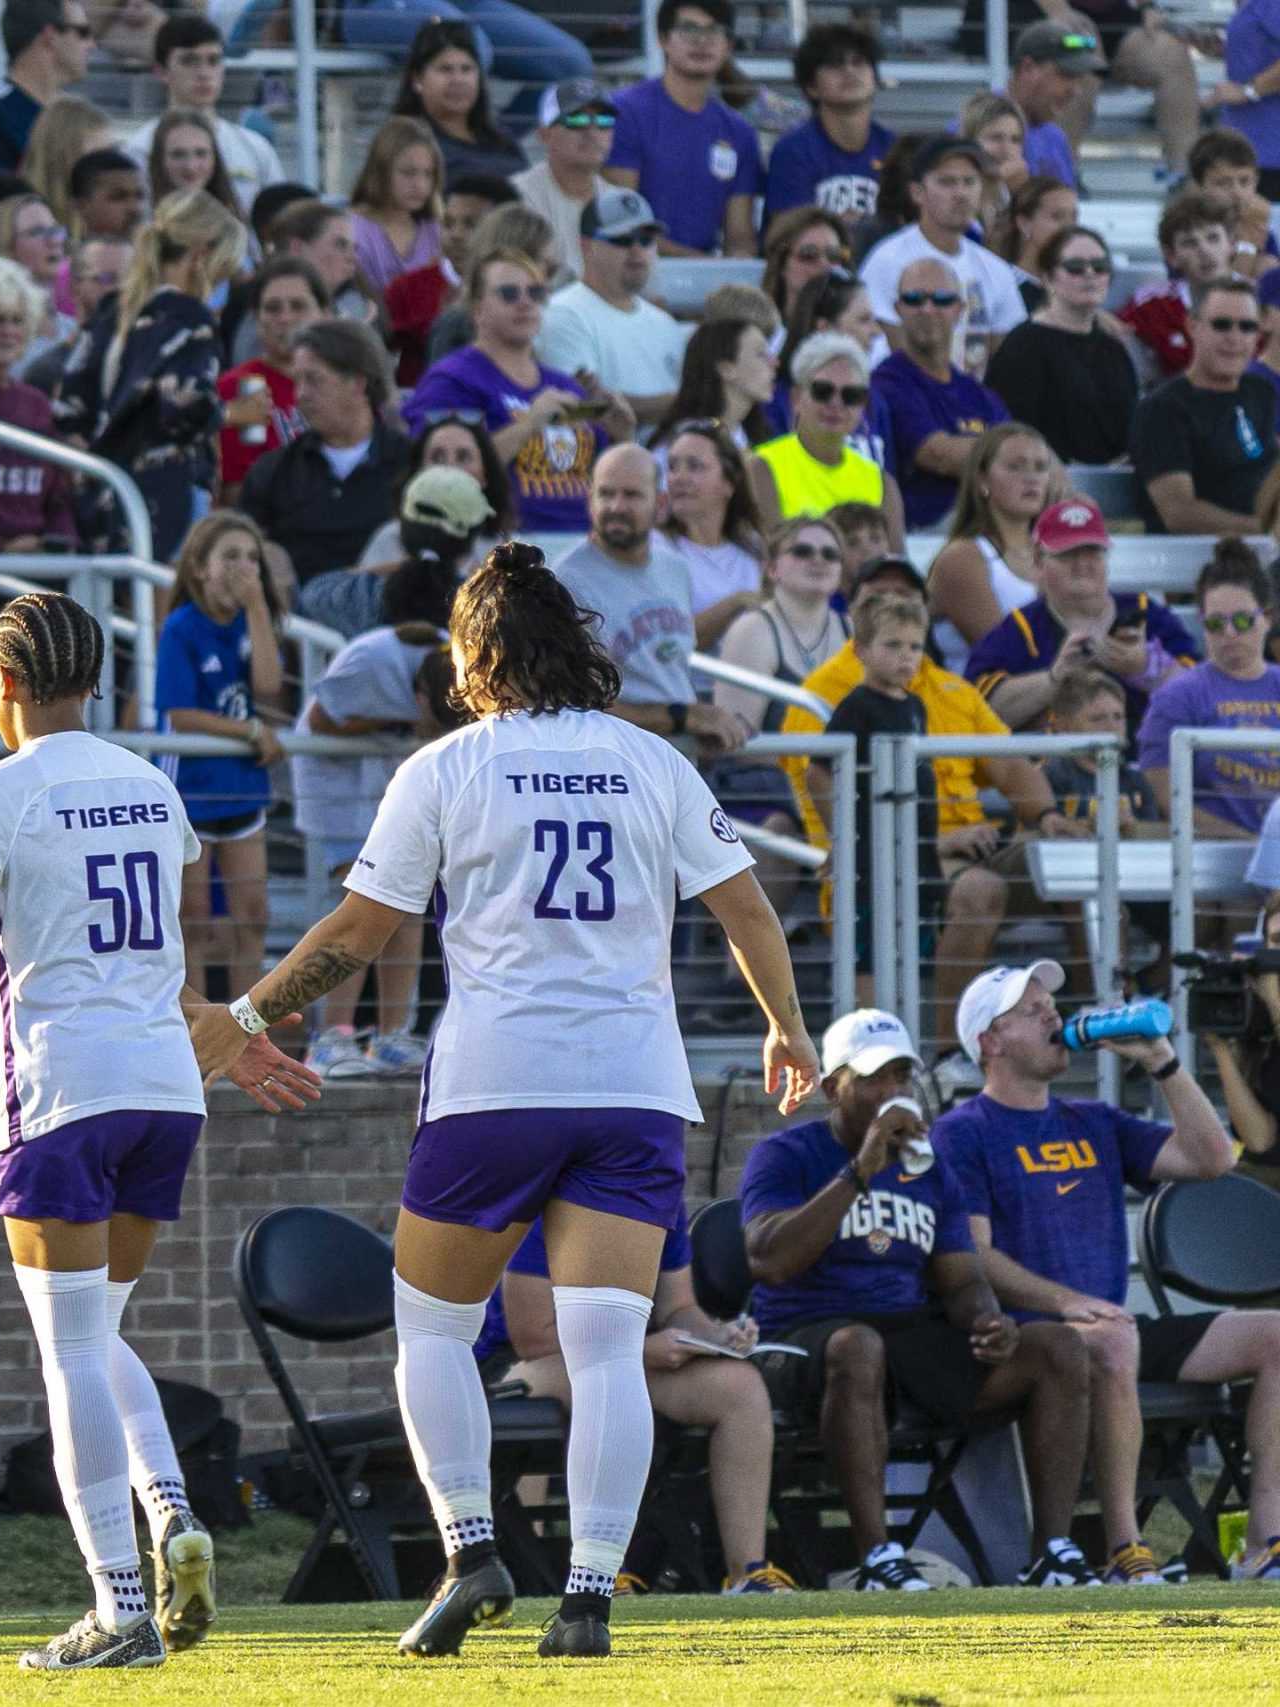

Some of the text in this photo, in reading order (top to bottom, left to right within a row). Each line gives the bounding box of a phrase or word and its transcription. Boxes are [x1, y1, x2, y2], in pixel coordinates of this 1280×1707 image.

[505, 773, 629, 794] TIGERS
[55, 803, 169, 830] TIGERS
[534, 819, 616, 922] 23
[85, 851, 164, 954] 50
[1017, 1139, 1098, 1174] LSU
